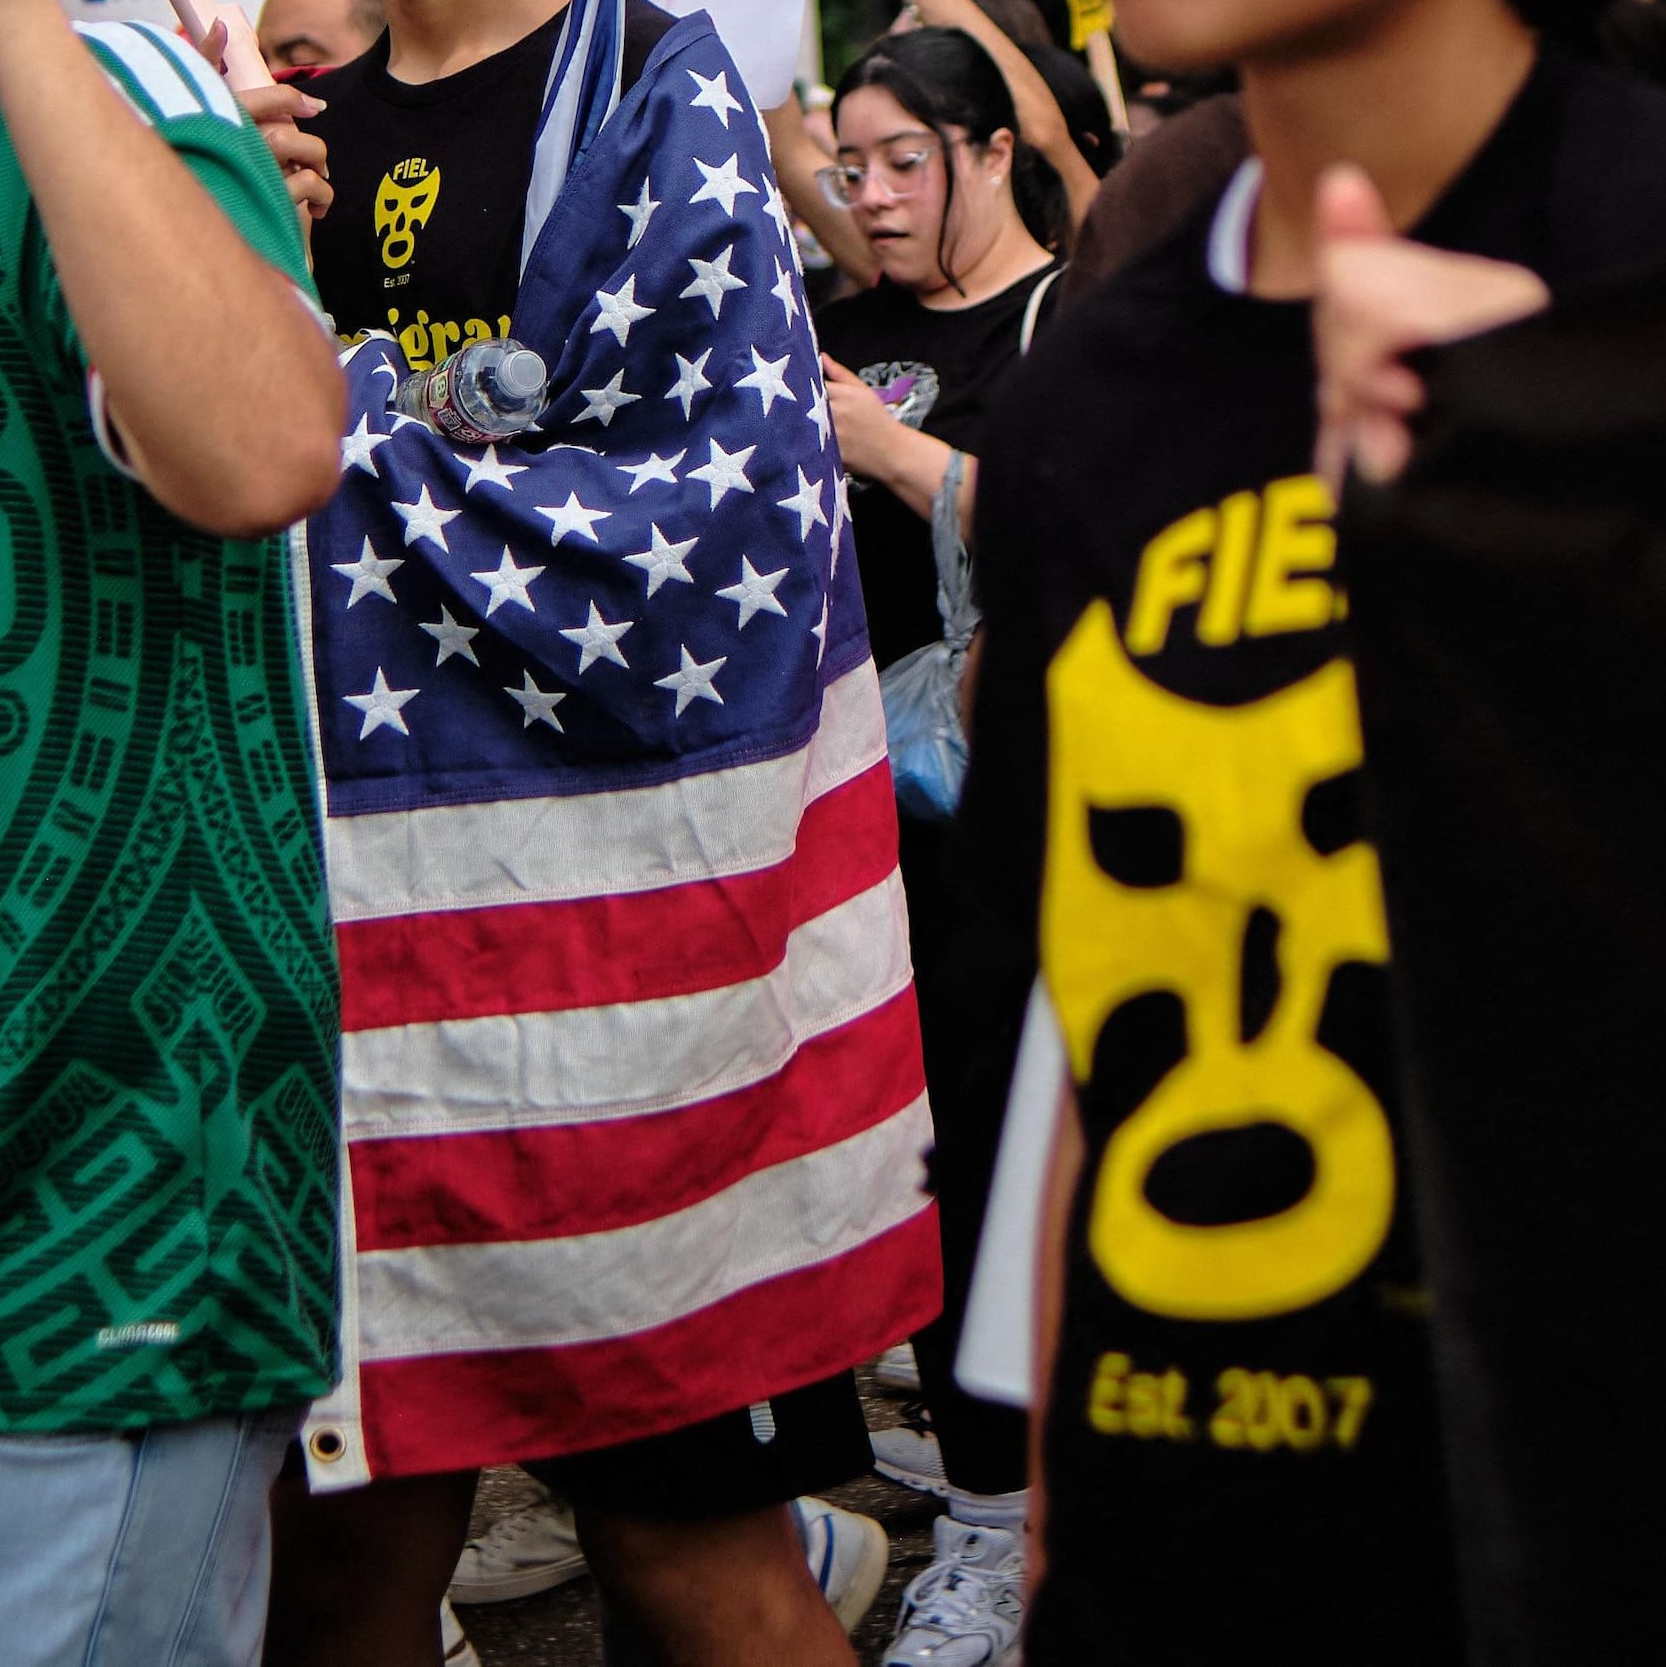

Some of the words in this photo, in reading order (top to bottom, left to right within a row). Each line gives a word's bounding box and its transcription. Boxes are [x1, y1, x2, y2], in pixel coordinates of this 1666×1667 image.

[393, 157, 429, 181] FIEL
[1125, 473, 1348, 656] FIE
[1211, 1363, 1373, 1453] 2007
